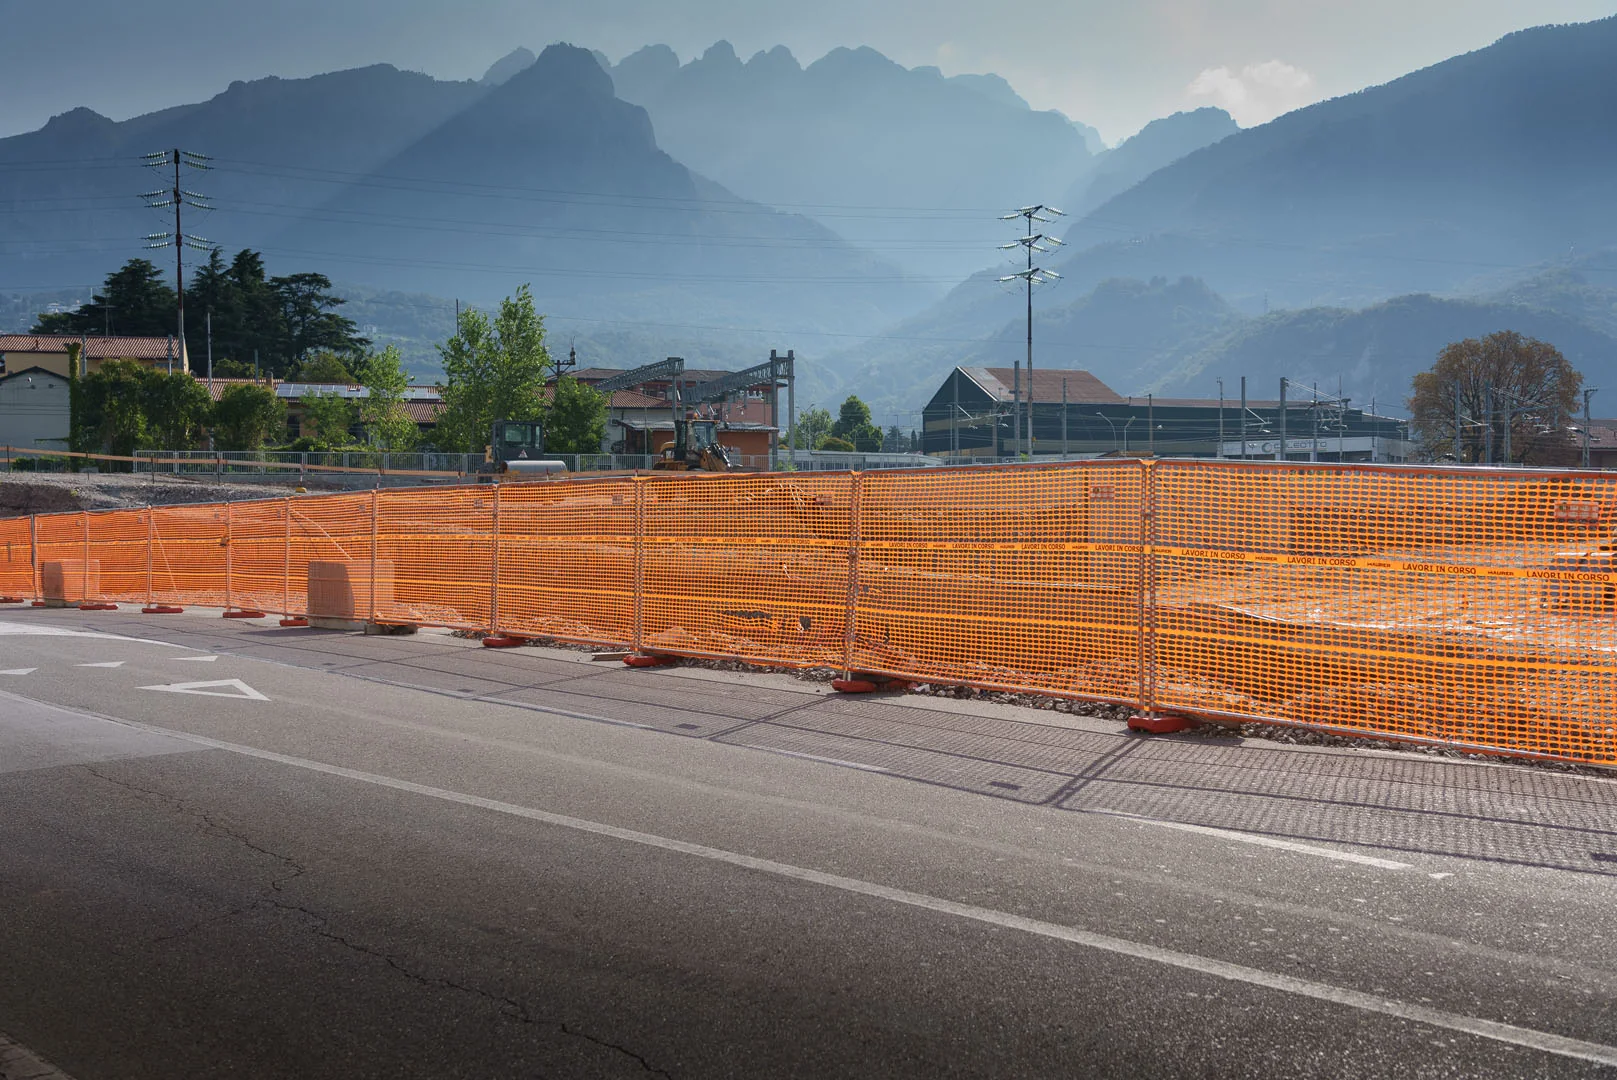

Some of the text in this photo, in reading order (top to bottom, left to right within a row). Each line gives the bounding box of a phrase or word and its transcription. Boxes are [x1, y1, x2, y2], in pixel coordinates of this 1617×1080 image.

[1181, 549, 1208, 558] LAVORI
[1220, 552, 1245, 560] CORSO
[1288, 556, 1315, 565] LAVORI
[1402, 563, 1433, 572] LAVORI
[1448, 566, 1476, 574] CORSO
[1526, 571, 1560, 579] LAVORI
[1576, 573, 1610, 582] CORSO
